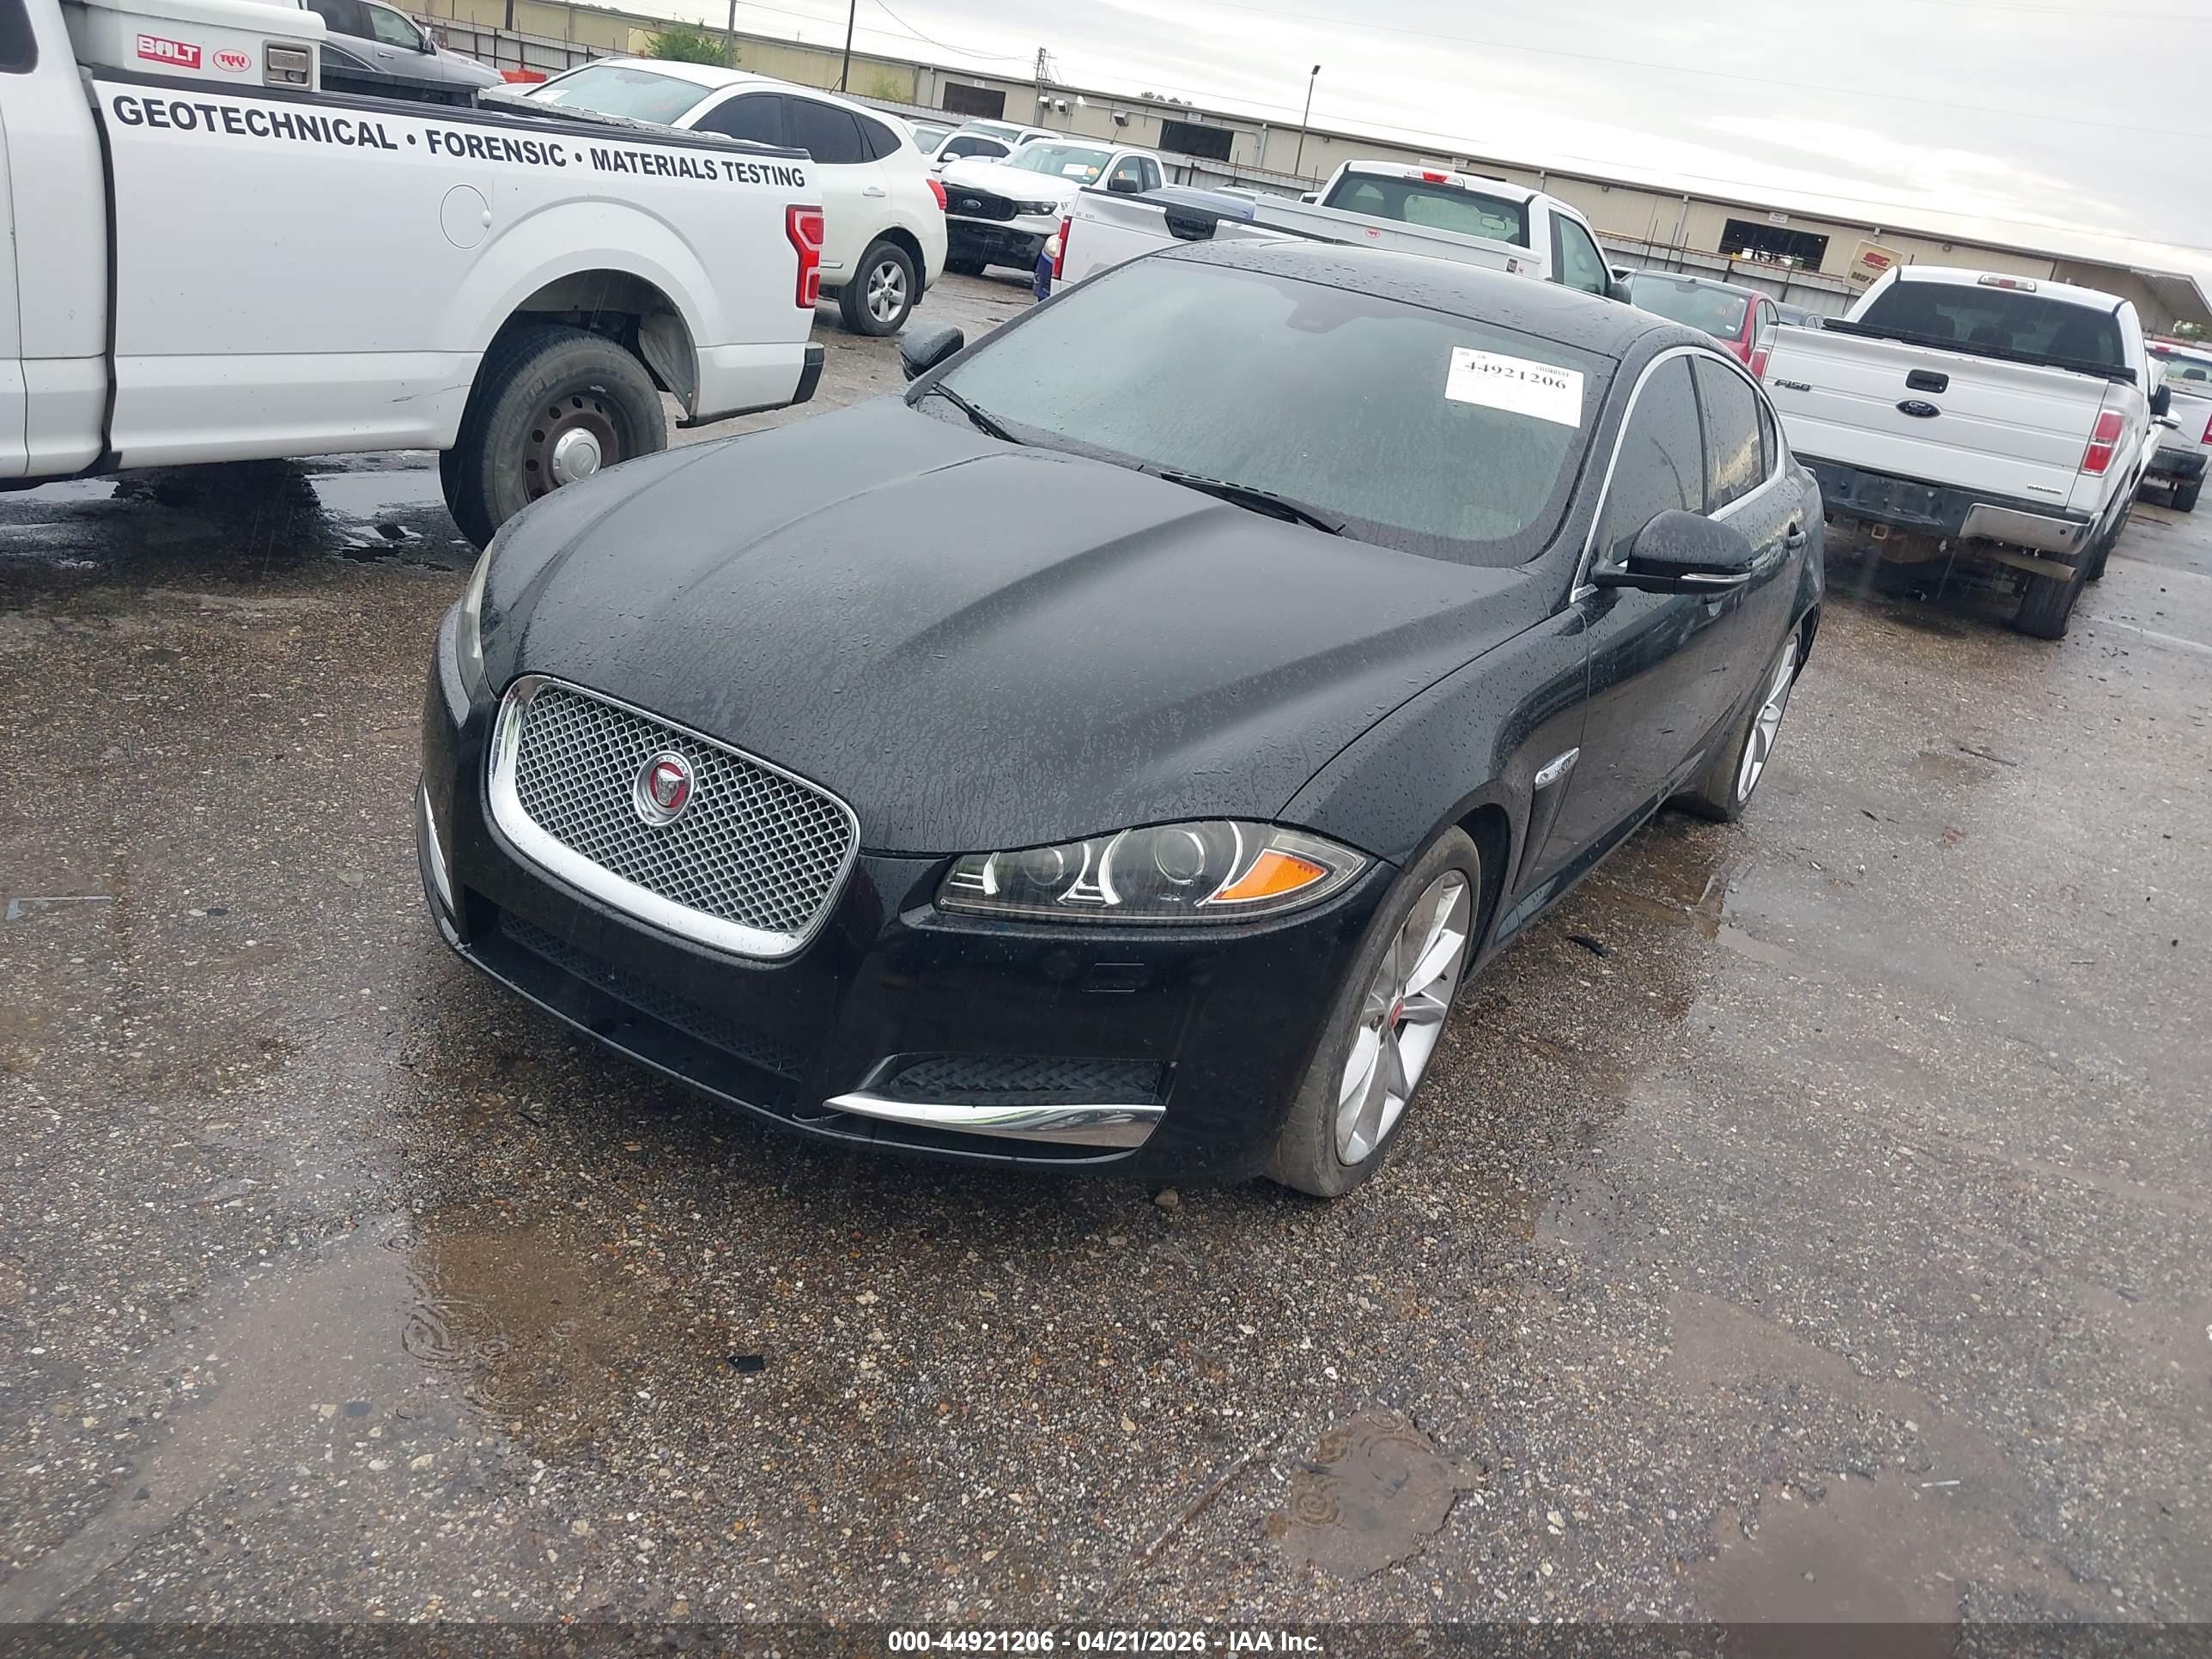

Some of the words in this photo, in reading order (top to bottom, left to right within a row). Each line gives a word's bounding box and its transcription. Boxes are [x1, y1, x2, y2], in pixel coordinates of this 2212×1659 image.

[137, 36, 198, 62] BOLT
[112, 94, 398, 150] GEOTECHNICAL
[424, 128, 567, 167] FORENSIC
[589, 148, 718, 181] MATERIALS
[720, 161, 805, 188] TESTING
[1464, 361, 1567, 390] 44921206
